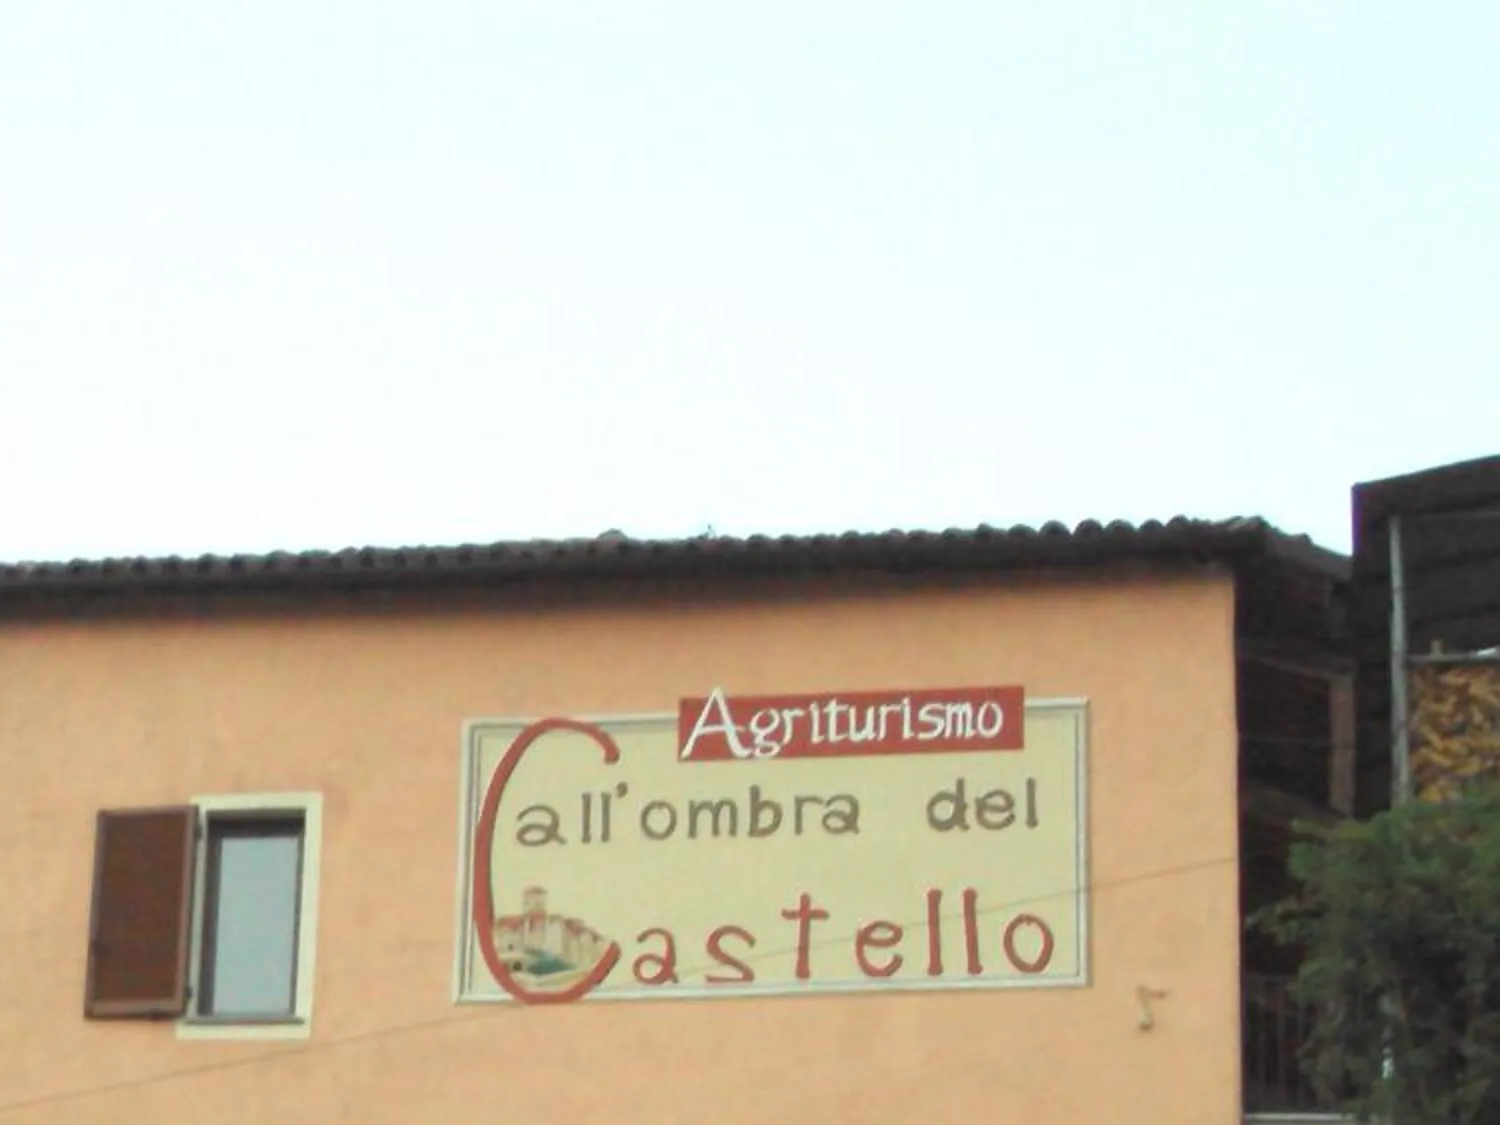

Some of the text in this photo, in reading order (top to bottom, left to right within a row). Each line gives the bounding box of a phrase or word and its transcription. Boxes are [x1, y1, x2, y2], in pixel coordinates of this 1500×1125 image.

[681, 687, 1003, 759] Agriturismo
[514, 777, 1040, 846] all'ombra del
[473, 717, 1055, 1005] Castello
